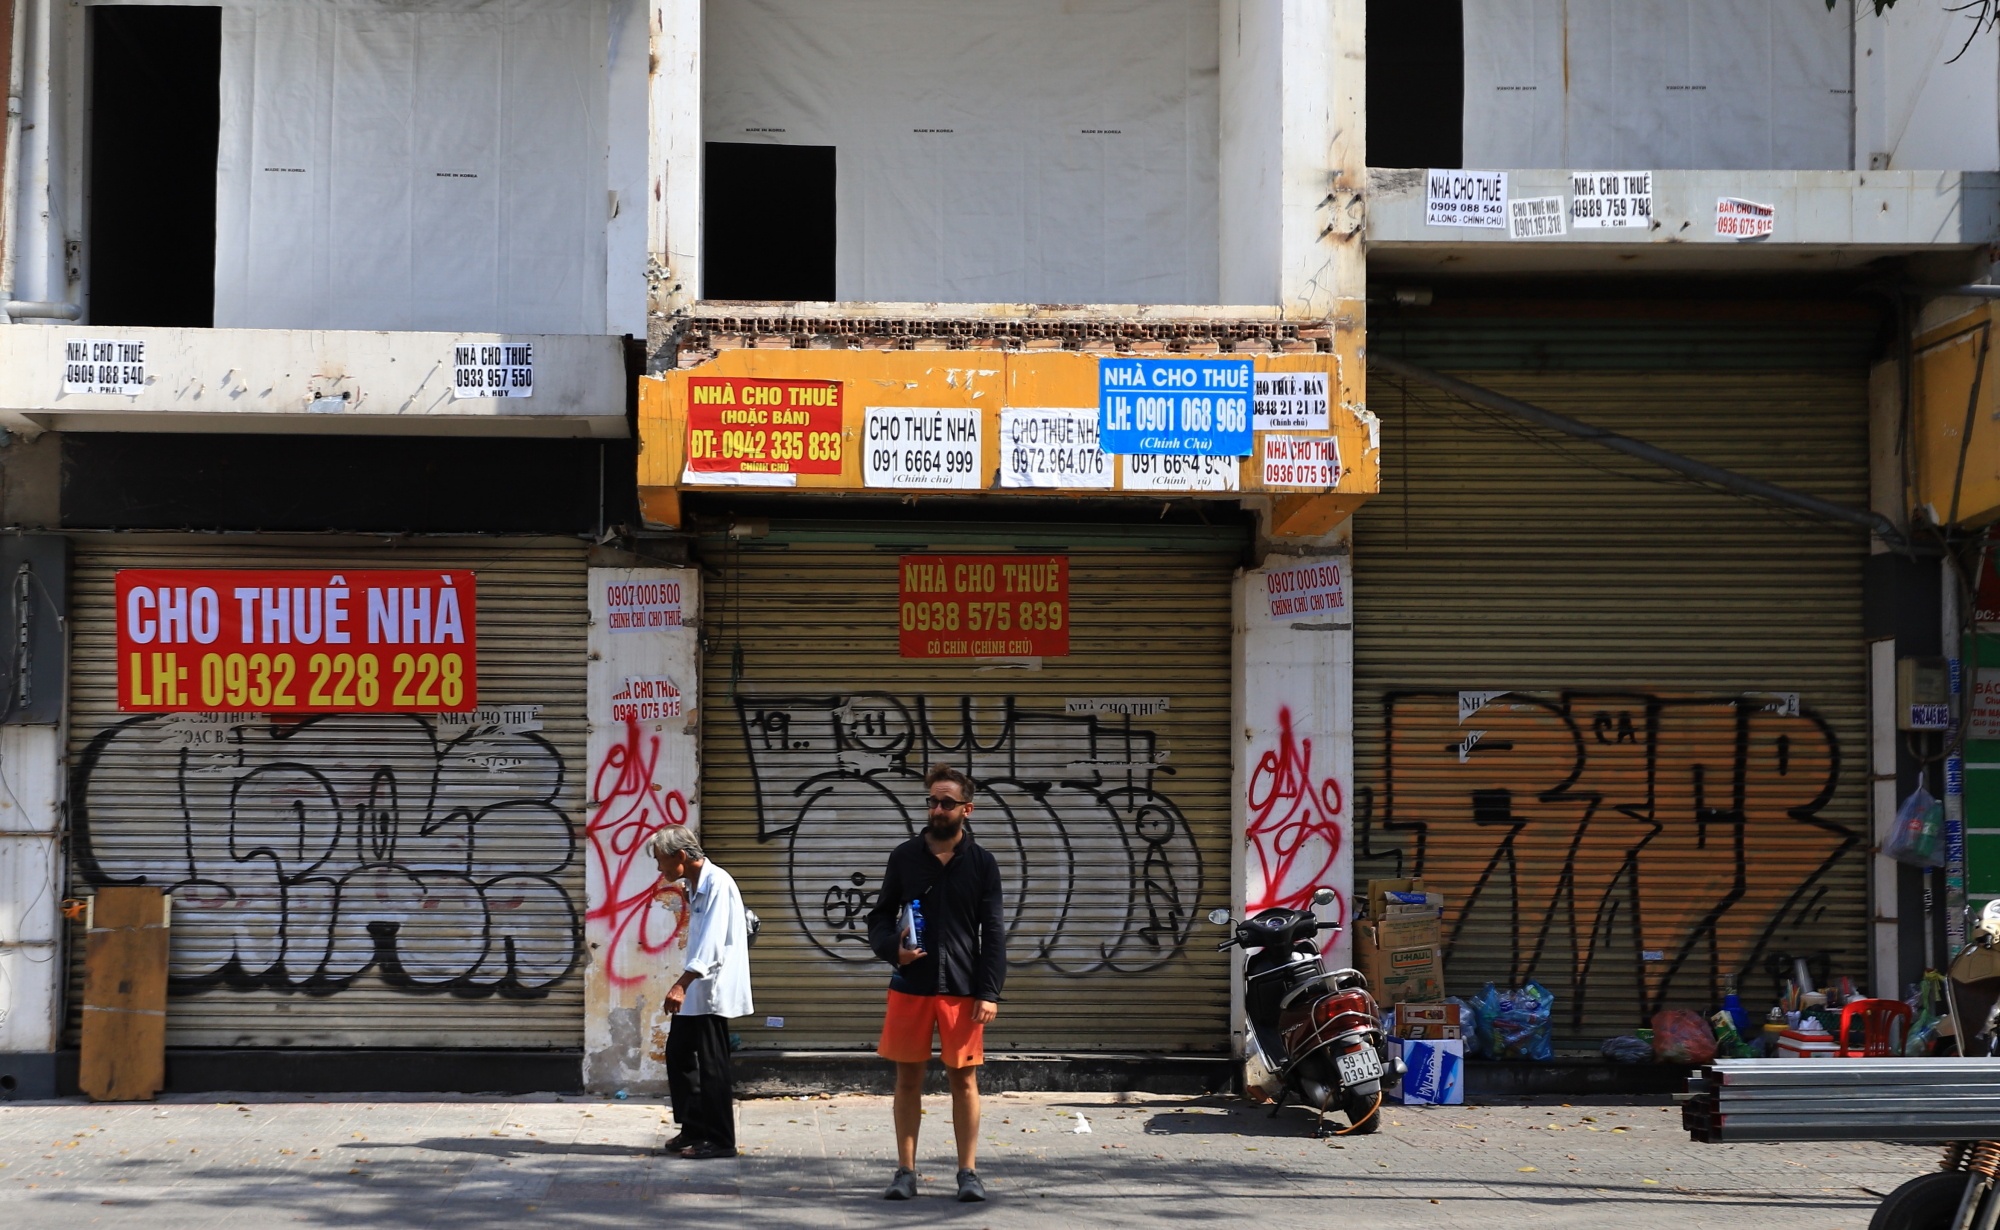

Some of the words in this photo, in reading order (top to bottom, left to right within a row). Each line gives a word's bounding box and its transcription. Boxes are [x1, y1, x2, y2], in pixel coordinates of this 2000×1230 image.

[1431, 171, 1452, 199] NHÀ
[1454, 179, 1474, 200] CHO
[1477, 173, 1502, 201] THUÊ
[1574, 174, 1595, 196] NHÀ
[1599, 177, 1619, 195] CHO
[1623, 172, 1651, 194] THUÊ
[1431, 202, 1457, 212] 0909
[1460, 203, 1480, 213] 088
[1483, 204, 1502, 214] 540
[1513, 203, 1527, 217] CHO
[1574, 199, 1602, 218] 0989
[1606, 199, 1627, 217] 759
[1631, 197, 1652, 216] 798
[1737, 203, 1752, 214] CHO
[1514, 214, 1562, 237] 0901.197.318
[1718, 216, 1737, 233] 0936
[1740, 217, 1755, 235] 075
[67, 339, 88, 361] NHÀ
[93, 343, 113, 362] CHO
[117, 341, 145, 363] THUÊ
[456, 343, 477, 365] NHÀ
[481, 347, 501, 366] CHO
[505, 343, 532, 365] THUÊ
[67, 364, 95, 383] 0909
[99, 365, 119, 384] 088
[123, 366, 144, 385] 540
[456, 368, 483, 388] 0933
[487, 368, 508, 388] 957
[511, 368, 532, 387] 550
[1105, 363, 1147, 387] NHÀ
[1152, 367, 1198, 388] CHO
[1203, 364, 1249, 388] THUÊ
[693, 382, 736, 405] NHÀ
[741, 386, 783, 406] CHO
[788, 384, 838, 407] THUÊ
[1254, 380, 1269, 396] HO
[1271, 376, 1296, 396] THUÊ
[1304, 377, 1323, 396] BÁN
[721, 409, 768, 428] (HOẶC
[772, 408, 811, 427] BÁN)
[1106, 396, 1131, 431] LH:
[1136, 397, 1175, 432] 0901
[1181, 397, 1212, 432] 068
[1216, 398, 1246, 432] 968
[1280, 400, 1292, 415] 21
[870, 415, 900, 442] CHO
[904, 411, 942, 442] THUÊ
[947, 411, 977, 443] NHÀ
[1012, 418, 1039, 445] CHO
[1042, 413, 1073, 444] THUÊ
[691, 429, 717, 459] ĐT:
[722, 430, 766, 459] 0942
[771, 431, 803, 460] 335
[808, 431, 841, 461] 833
[1139, 436, 1180, 450] (Chính
[1183, 437, 1213, 450] Chủ)
[1291, 441, 1311, 460] CHO
[1315, 441, 1338, 461] THU
[740, 459, 769, 472] CHÍNH
[873, 449, 899, 473] 091
[904, 450, 942, 473] 6664
[946, 450, 974, 474] 999
[1012, 448, 1104, 474] 0972.964.076
[1132, 454, 1157, 474] 091
[892, 472, 929, 485] (Chính
[1266, 463, 1293, 483] 0936
[1297, 465, 1317, 483] 075
[1321, 465, 1340, 484] 915
[905, 557, 948, 593] NHÀ
[954, 563, 996, 593] CHO
[1003, 558, 1059, 592] THUÊ
[127, 586, 220, 645] CHO
[234, 574, 349, 645] THUÊ
[367, 574, 465, 645] NHÀ
[1271, 595, 1293, 616] CHÍNH
[1293, 591, 1309, 613] CHỦ
[1310, 594, 1325, 611] CHO
[1325, 587, 1344, 608] THUÊ
[609, 608, 631, 629] CHÍNH
[632, 606, 647, 628] CHỦ
[648, 610, 663, 627] CHO
[664, 606, 682, 626] THUÊ
[902, 601, 960, 631] 0938
[968, 602, 1011, 631] 575
[1019, 601, 1063, 631] 839
[928, 638, 941, 655] CÔ
[943, 637, 968, 655] CHÍN
[971, 637, 1006, 656] (CHÍNH
[1008, 637, 1033, 656] CHỦ)
[130, 652, 189, 707] LH:
[201, 652, 297, 708] 0932
[309, 652, 380, 708] 228
[393, 652, 464, 708] 228
[634, 681, 653, 699] CHO
[613, 705, 638, 722] 0936
[641, 703, 660, 720] 075
[662, 701, 681, 718] 915
[1394, 952, 1431, 962] U-HAUL
[1342, 1051, 1372, 1070] 59-T1
[1344, 1063, 1380, 1084] 039.45
